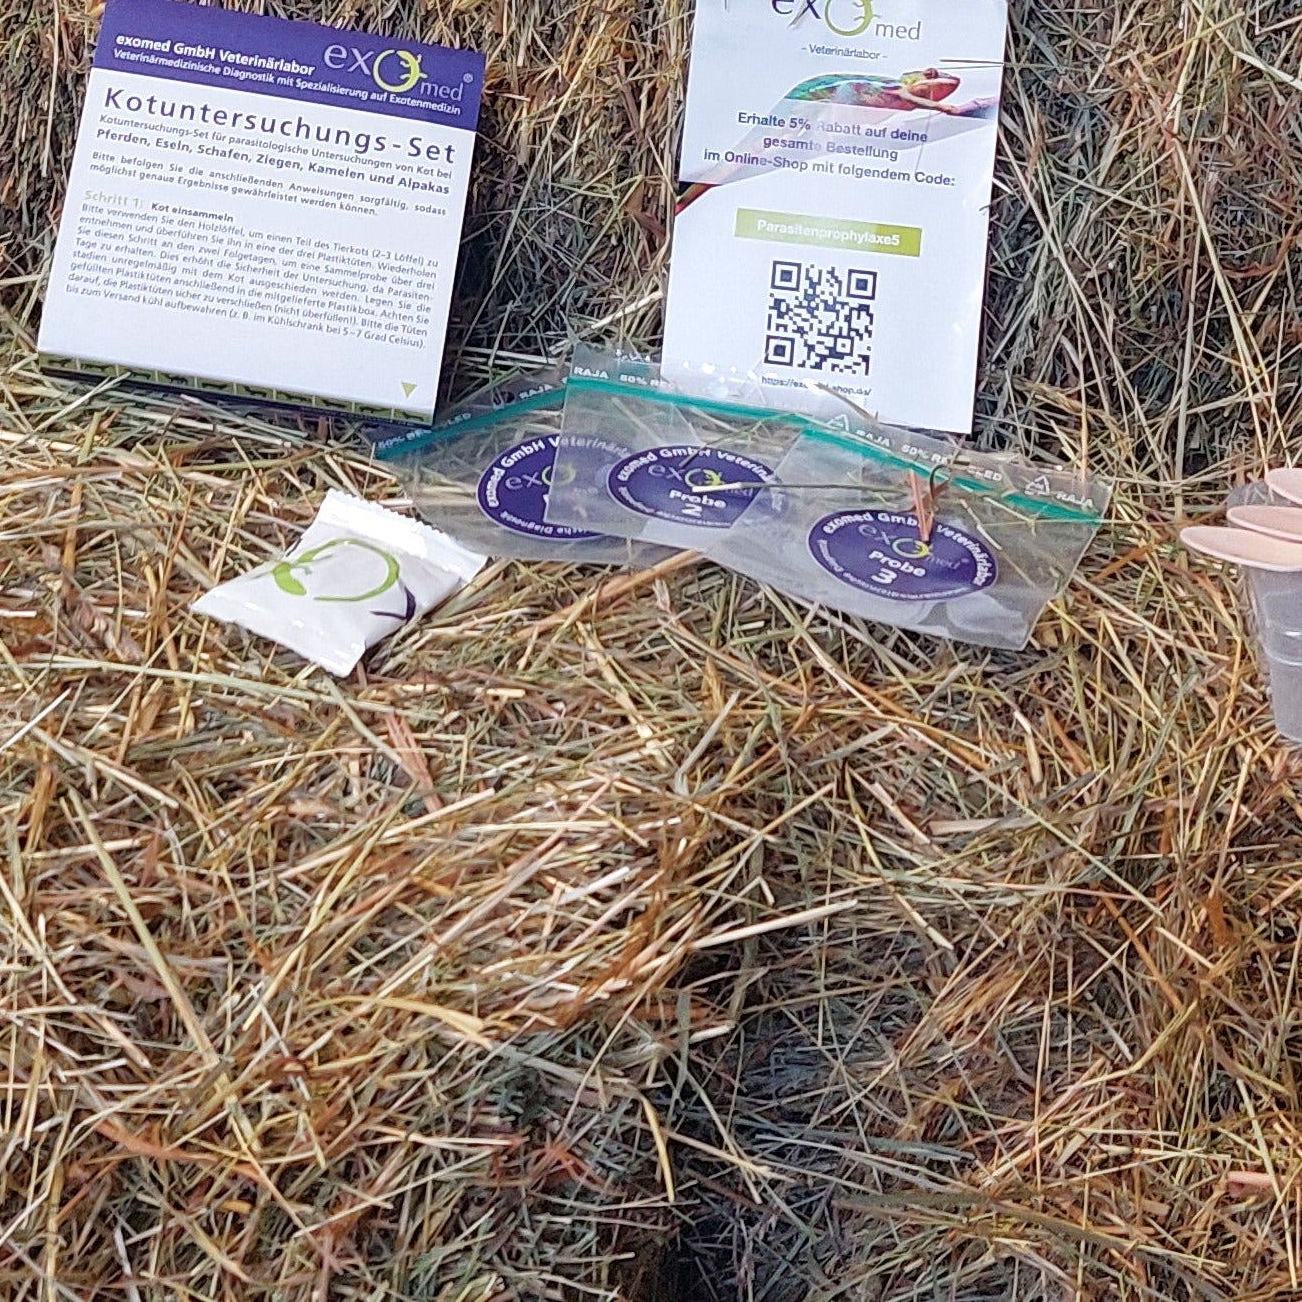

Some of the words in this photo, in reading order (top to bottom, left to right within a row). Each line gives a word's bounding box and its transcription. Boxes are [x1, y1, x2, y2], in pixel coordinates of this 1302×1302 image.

[115, 35, 171, 52] exomed
[173, 42, 215, 59] GmbH
[218, 49, 315, 75] Veterinärlabor
[112, 47, 221, 74] Veterinärmedizinische
[222, 65, 274, 83] Diagnostik
[276, 76, 293, 86] mit
[295, 78, 368, 100] Spezialisierung
[369, 91, 387, 101] auf
[389, 93, 460, 115] Exotenmedizin
[99, 114, 208, 139] Kotuntersuchungs-Set
[211, 131, 226, 141] für
[228, 136, 308, 155] parasitologische
[310, 147, 392, 169] Untersuchungen
[394, 163, 413, 172] von
[416, 165, 433, 176] Kot
[436, 168, 452, 179] bei
[104, 88, 456, 164] Kotuntersuchungs-Set
[738, 111, 786, 130] Erhalte
[788, 115, 811, 131] 5%
[816, 120, 863, 137] Rabatt
[865, 124, 887, 139] auf
[890, 127, 928, 143] deine
[763, 136, 821, 154] gesamte
[825, 140, 899, 161] Bestellung
[92, 151, 115, 162] Bitte
[120, 155, 163, 169] befolgen
[168, 163, 183, 172] Sie
[188, 166, 203, 175] die
[208, 171, 283, 188] anschließenden
[288, 182, 354, 200] Anweisungen
[414, 204, 445, 215] sodass
[96, 128, 150, 146] Pferden,
[155, 137, 192, 153] Eseln,
[196, 144, 251, 162] Schafen,
[255, 153, 303, 171] Ziegen,
[307, 161, 364, 180] Kamelen
[368, 173, 394, 184] und
[397, 177, 449, 194] Alpakas
[703, 148, 720, 163] im
[724, 151, 810, 173] Online-Shop
[812, 159, 834, 174] mit
[837, 161, 911, 182] folgendem
[914, 169, 956, 187] Code:
[84, 189, 128, 206] Schritt
[89, 163, 136, 177] möglichst
[138, 171, 174, 182] genaue
[177, 176, 228, 191] Ergebnisse
[231, 186, 297, 202] gewährleistet
[300, 197, 336, 208] werden
[81, 202, 103, 214] Bitte
[106, 208, 157, 222] verwenden
[160, 215, 174, 225] Sie
[176, 217, 195, 228] den
[248, 230, 263, 239] um
[266, 234, 292, 243] einen
[295, 236, 311, 246] Teil
[313, 240, 329, 249] des
[333, 242, 368, 256] Tierkots
[426, 259, 438, 267] zu
[151, 202, 169, 212] Kot
[171, 206, 233, 222] einsammeln
[756, 219, 901, 247] Parasitenprophylaxe5
[75, 237, 97, 249] Tage
[159, 250, 179, 261] Dies
[182, 255, 213, 266] erhöht
[216, 259, 231, 269] die
[234, 261, 279, 277] Sicherheit
[283, 270, 299, 279] der
[372, 284, 384, 293] da
[77, 225, 91, 235] Sie
[94, 229, 124, 240] diesen
[127, 233, 157, 246] Schritt
[161, 240, 173, 248] an
[176, 241, 194, 251] den
[198, 246, 219, 255] zwei
[281, 259, 296, 267] um
[300, 262, 320, 271] eine
[323, 264, 387, 282] Sammelprobe
[391, 275, 412, 286] über
[416, 279, 434, 290] drei
[79, 216, 132, 230] entnehmen
[134, 225, 153, 233] und
[155, 226, 208, 242] überführen
[210, 234, 224, 244] Sie
[226, 237, 241, 247] ihn
[244, 239, 253, 249] in
[255, 243, 275, 252] eine
[278, 246, 294, 255] der
[296, 248, 315, 258] drei
[377, 261, 436, 278] Wiederholen
[70, 261, 113, 274] gefüllten
[115, 267, 171, 283] Plastiktüten
[173, 278, 234, 293] anschließend
[264, 291, 325, 307] mitgelieferte
[379, 309, 413, 322] Achten
[72, 249, 106, 261] stadien
[111, 256, 177, 274] unregelmäßig
[181, 267, 197, 276] mit
[202, 268, 222, 279] dem
[227, 273, 244, 283] Kot
[248, 278, 317, 294] ausgeschieden
[364, 294, 393, 306] Legen
[397, 300, 411, 309] Sie
[102, 289, 140, 302] Versand
[141, 295, 163, 305] kühl
[164, 300, 227, 316] aufbewahren
[267, 315, 323, 331] Kühlschrank
[363, 330, 386, 341] Grad
[119, 280, 173, 295] Plastiktüten
[175, 289, 201, 299] sicher
[273, 303, 299, 316] (nicht
[360, 317, 382, 328] Bitte
[401, 324, 427, 336] Tüten
[573, 366, 609, 380] RAJA
[501, 439, 546, 467] GmbH
[669, 489, 728, 509] Probe
[823, 512, 874, 535] exomed
[878, 512, 921, 527] Gmb
[868, 550, 927, 578] Probe
[871, 568, 898, 585] 3
